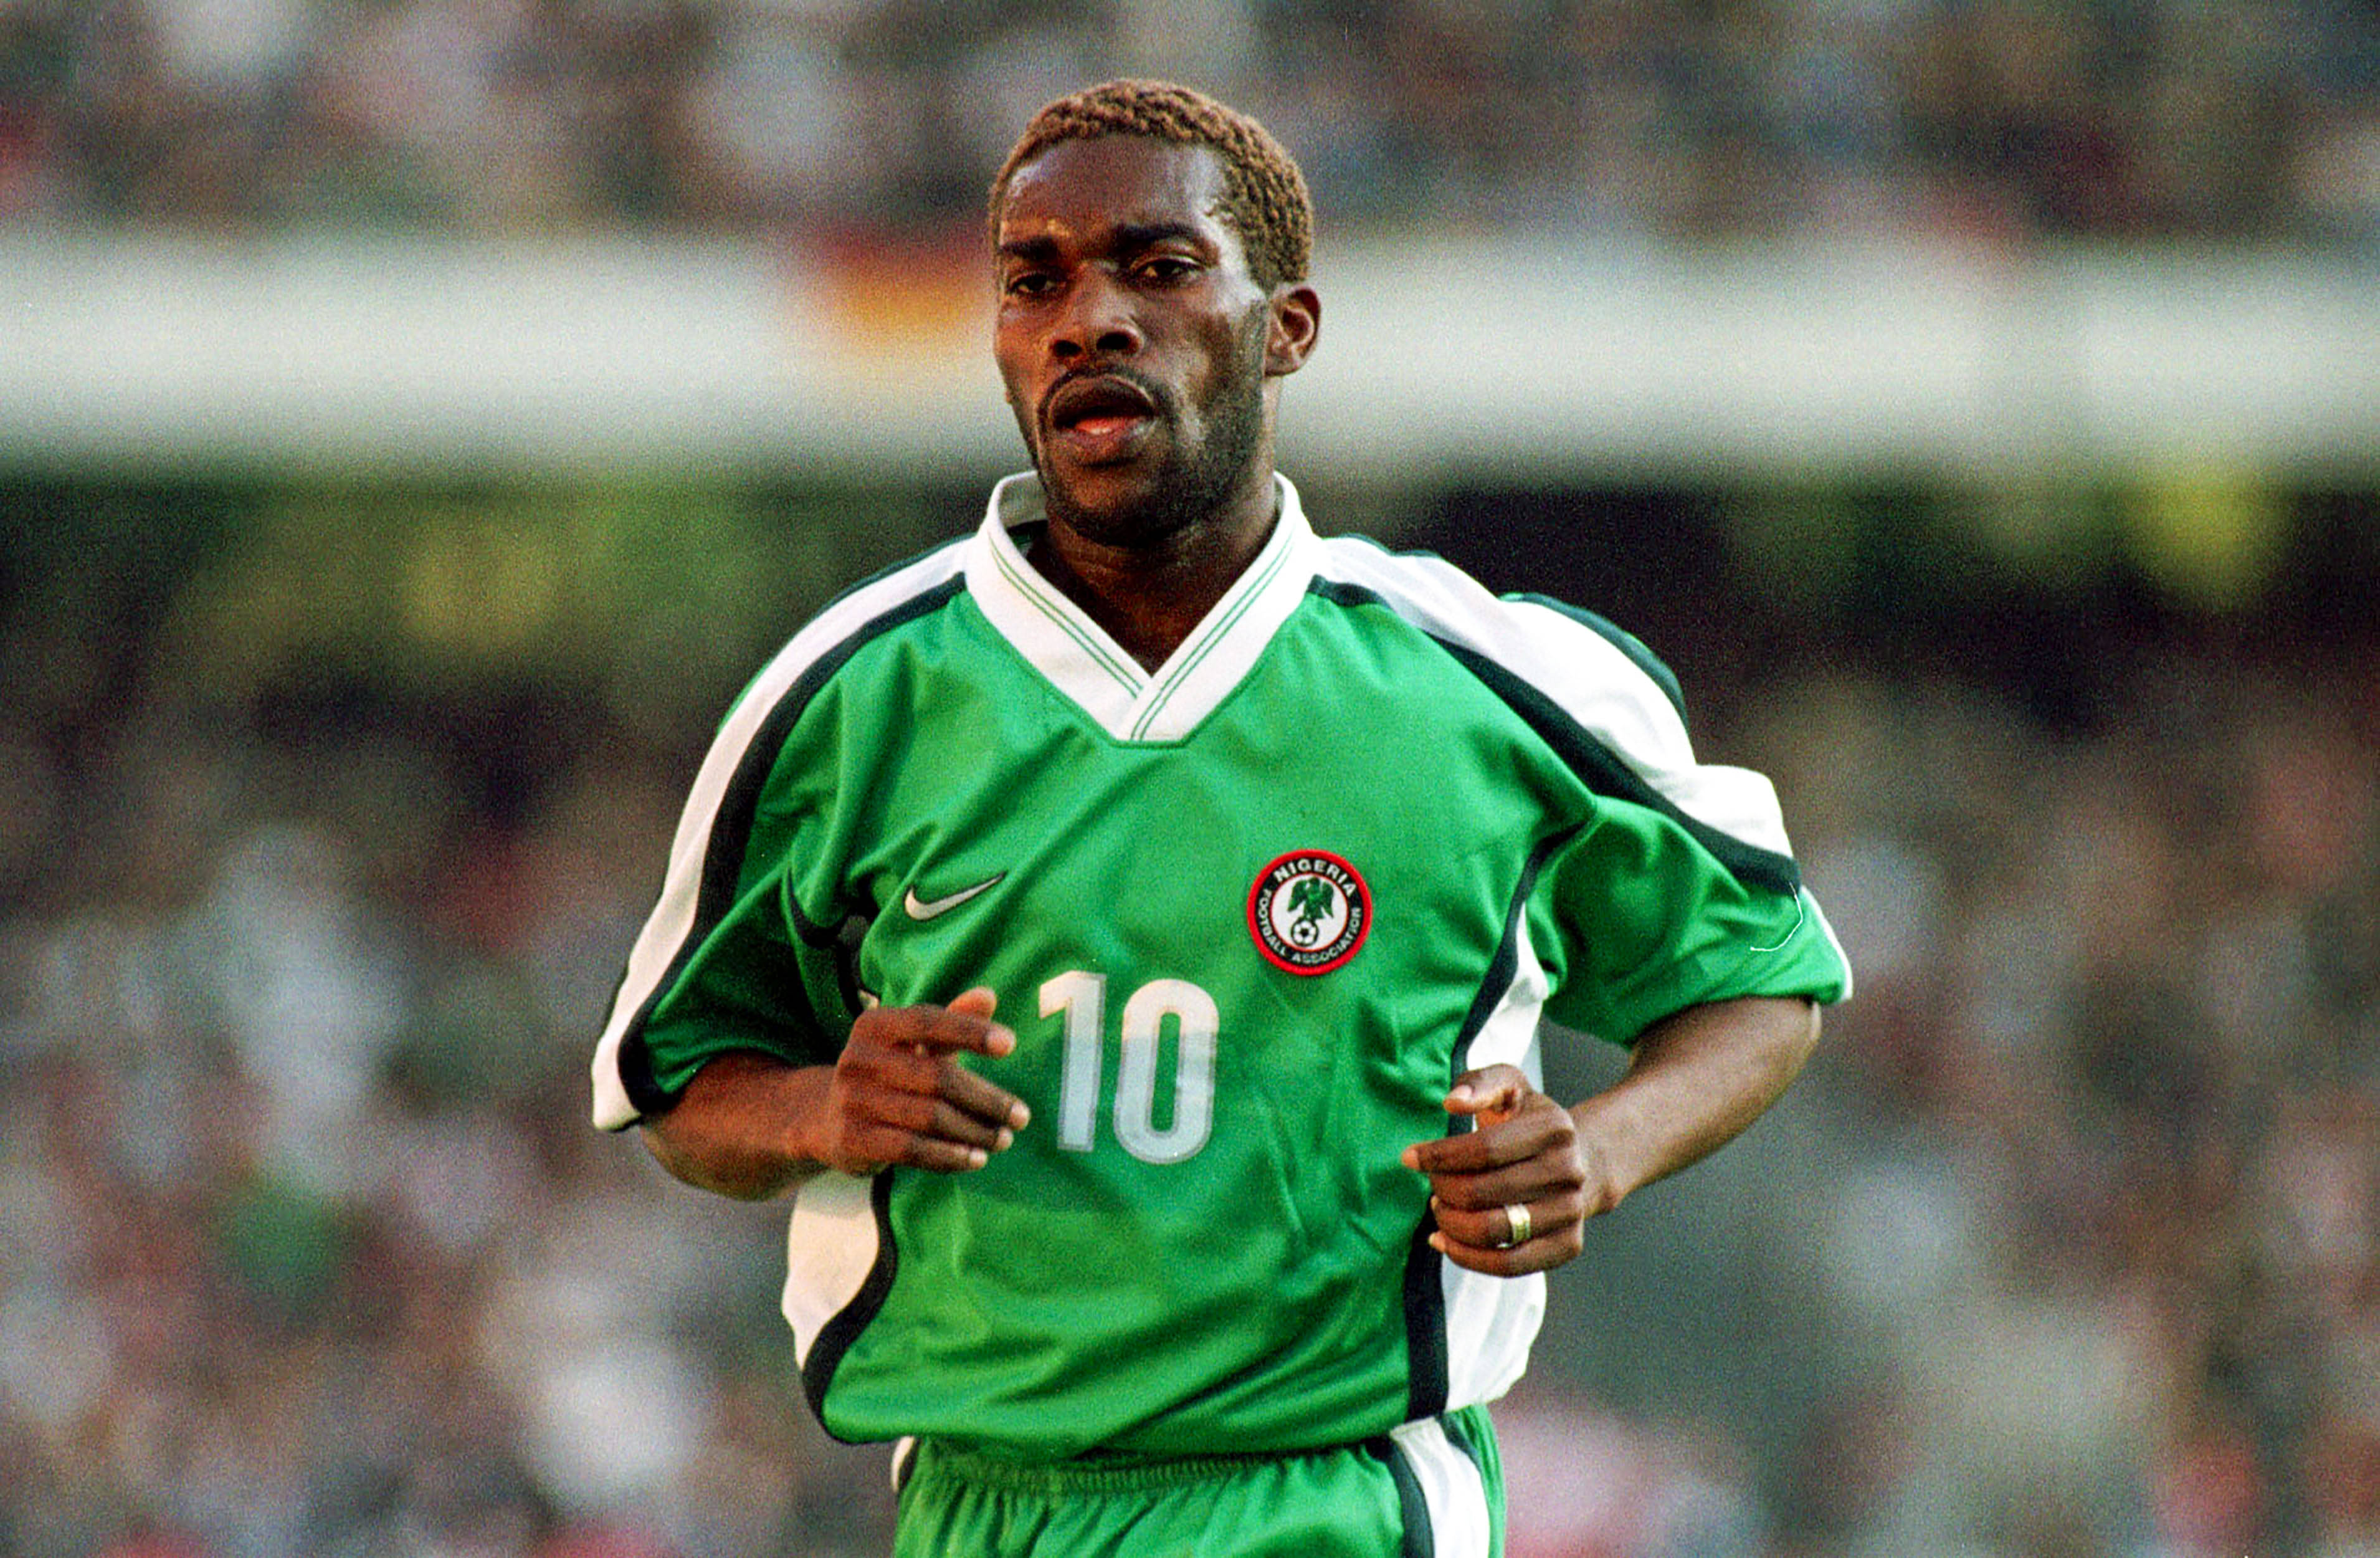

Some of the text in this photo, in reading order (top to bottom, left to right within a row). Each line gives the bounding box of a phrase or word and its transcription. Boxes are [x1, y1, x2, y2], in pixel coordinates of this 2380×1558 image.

[1273, 858, 1356, 897] NIGERIA
[1258, 888, 1362, 963] FOOTBALL ASSOCIATION
[1039, 970, 1219, 1165] 10
